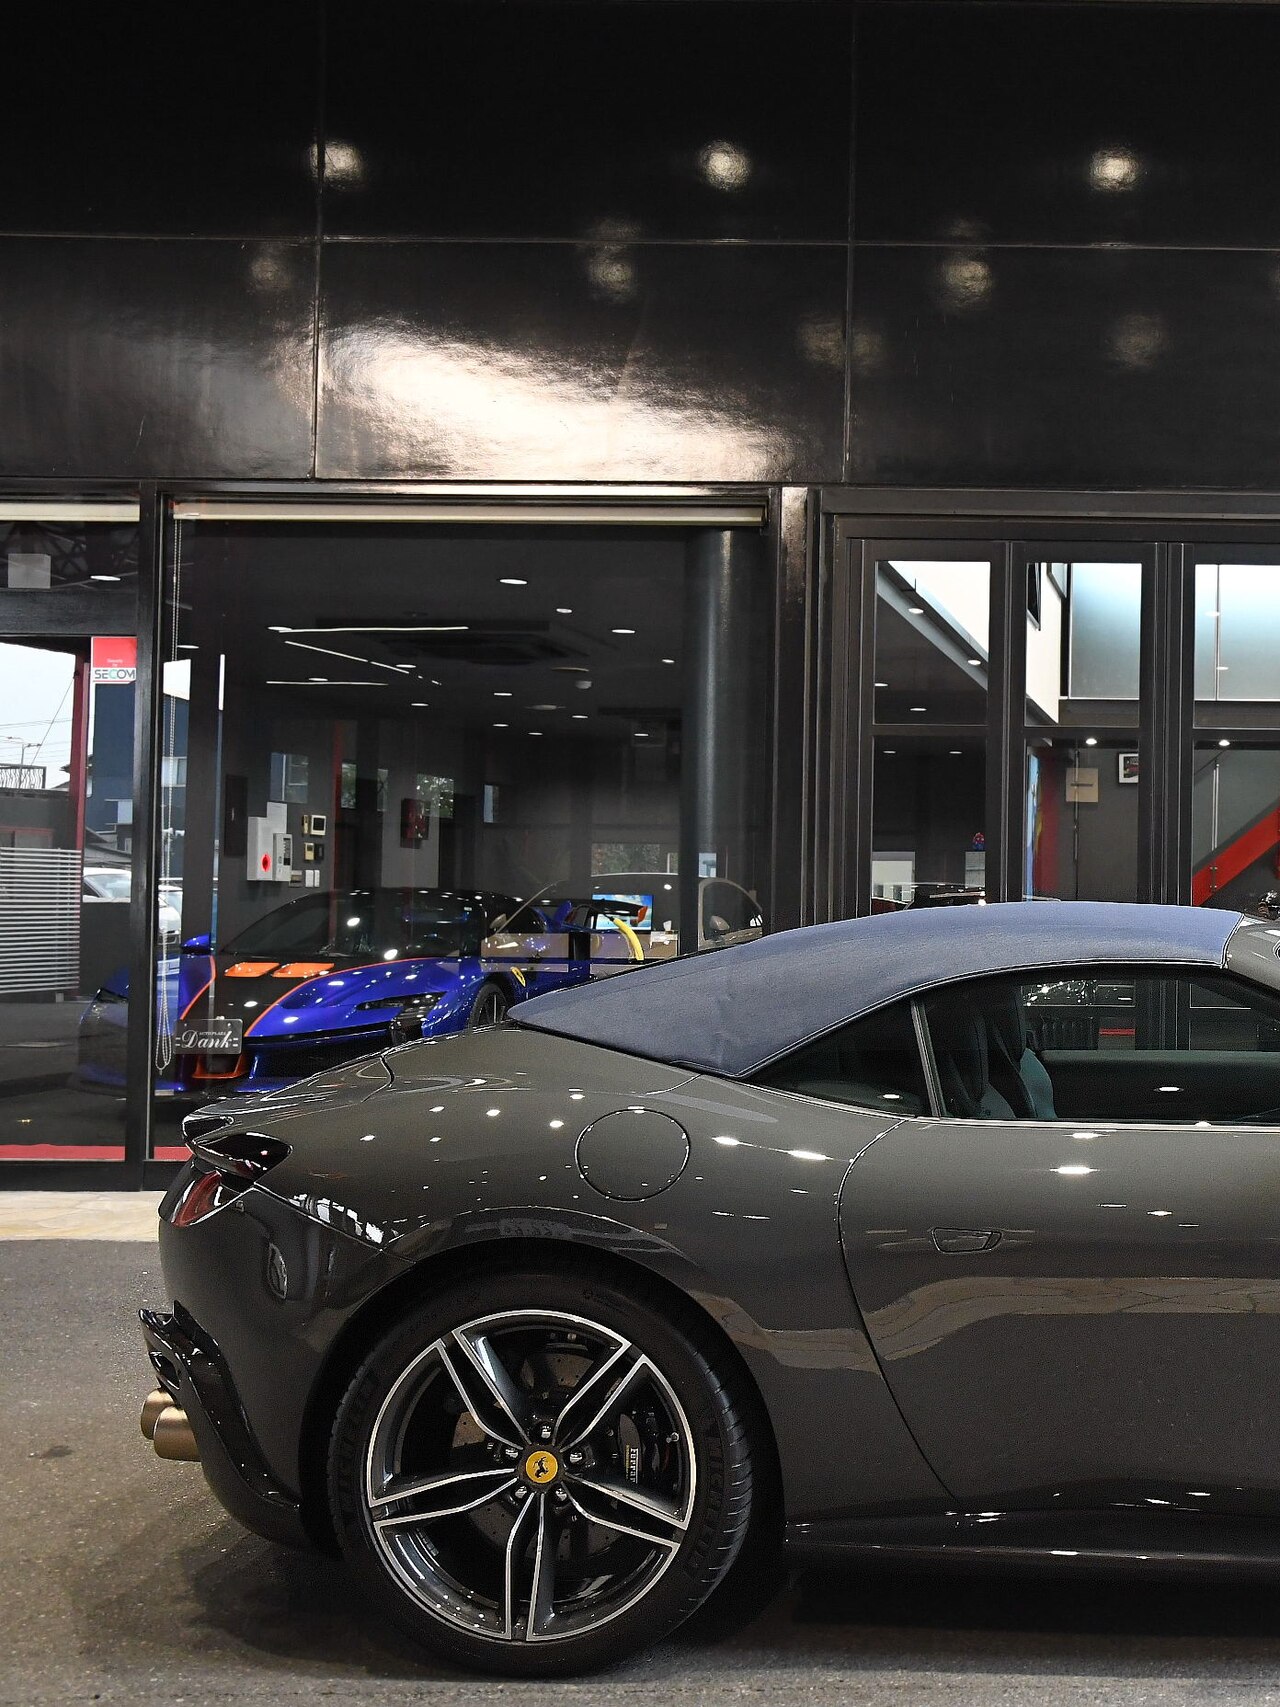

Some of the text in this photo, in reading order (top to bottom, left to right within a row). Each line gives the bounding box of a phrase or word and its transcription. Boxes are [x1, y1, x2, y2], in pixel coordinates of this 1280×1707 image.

[94, 669, 136, 679] SECOM
[181, 1029, 232, 1049] Dank
[629, 1447, 639, 1485] Ferrar
